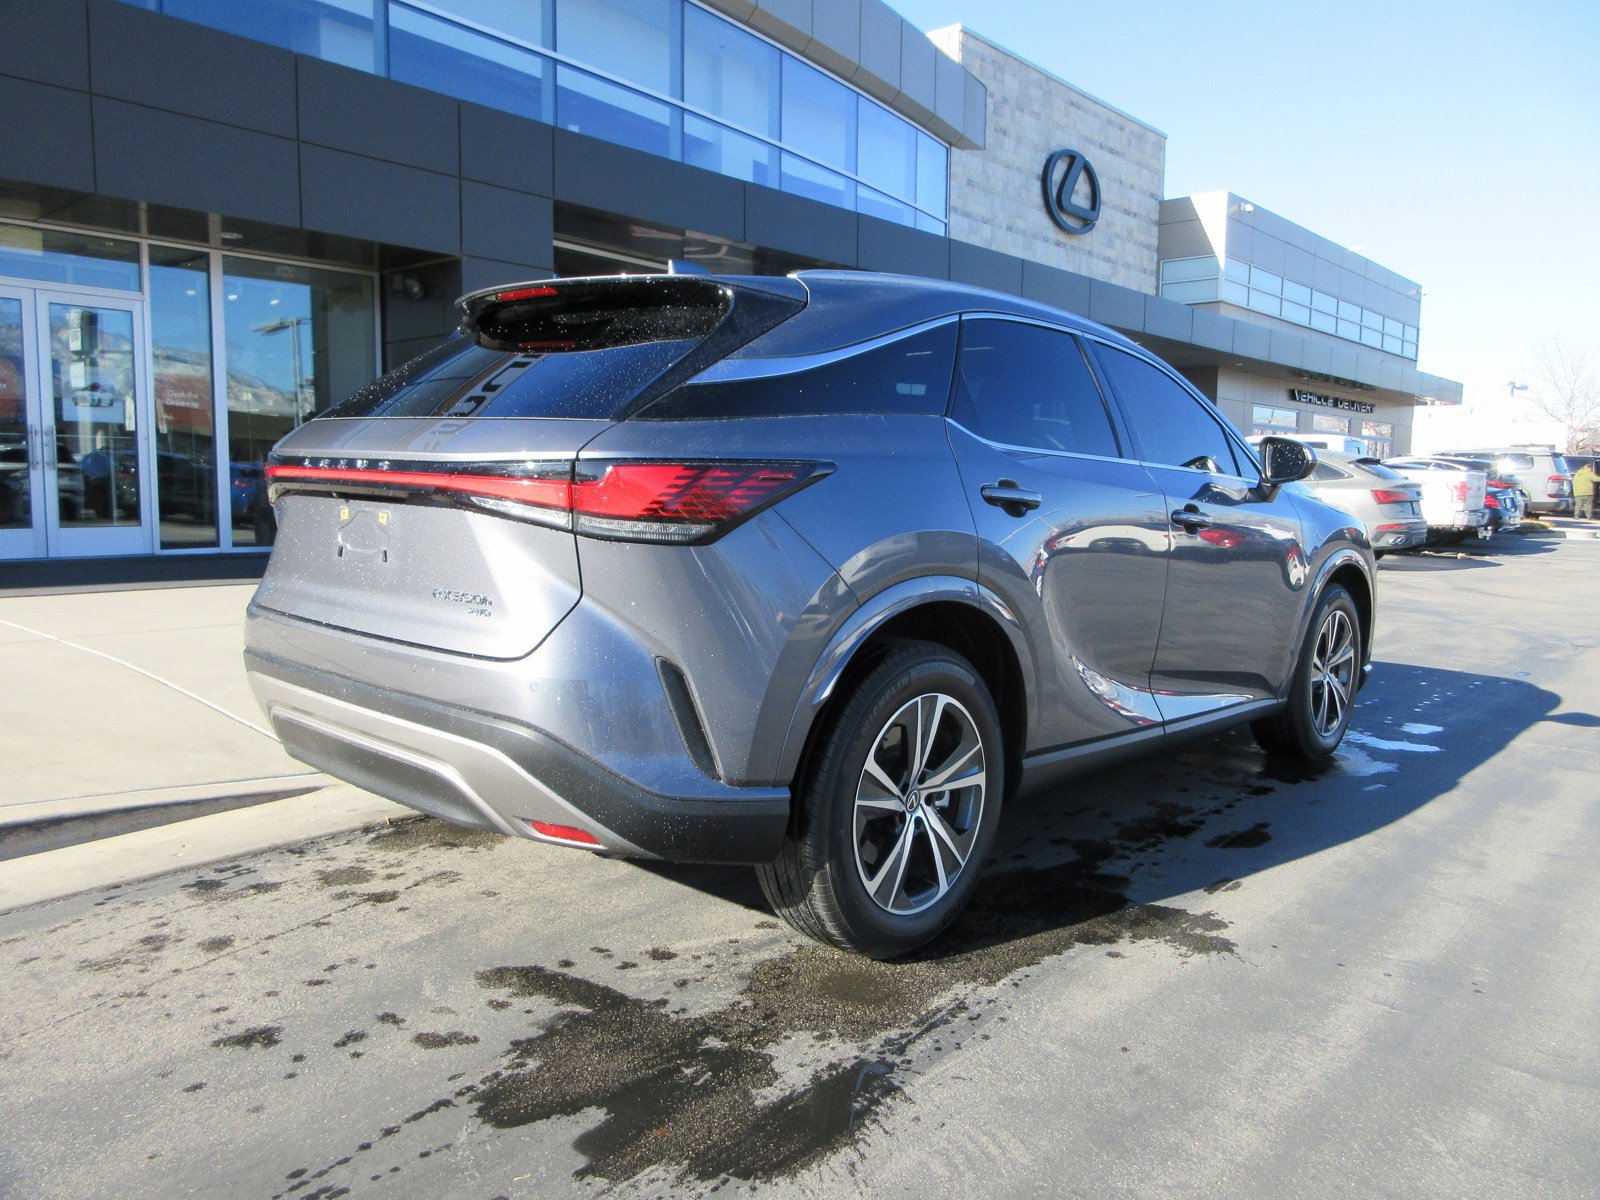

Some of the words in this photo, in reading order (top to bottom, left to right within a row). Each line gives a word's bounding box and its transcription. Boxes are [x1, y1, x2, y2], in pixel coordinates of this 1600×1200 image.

[187, 391, 199, 399] the
[1289, 389, 1333, 407] VEHICLE
[303, 458, 390, 470] LEXUS
